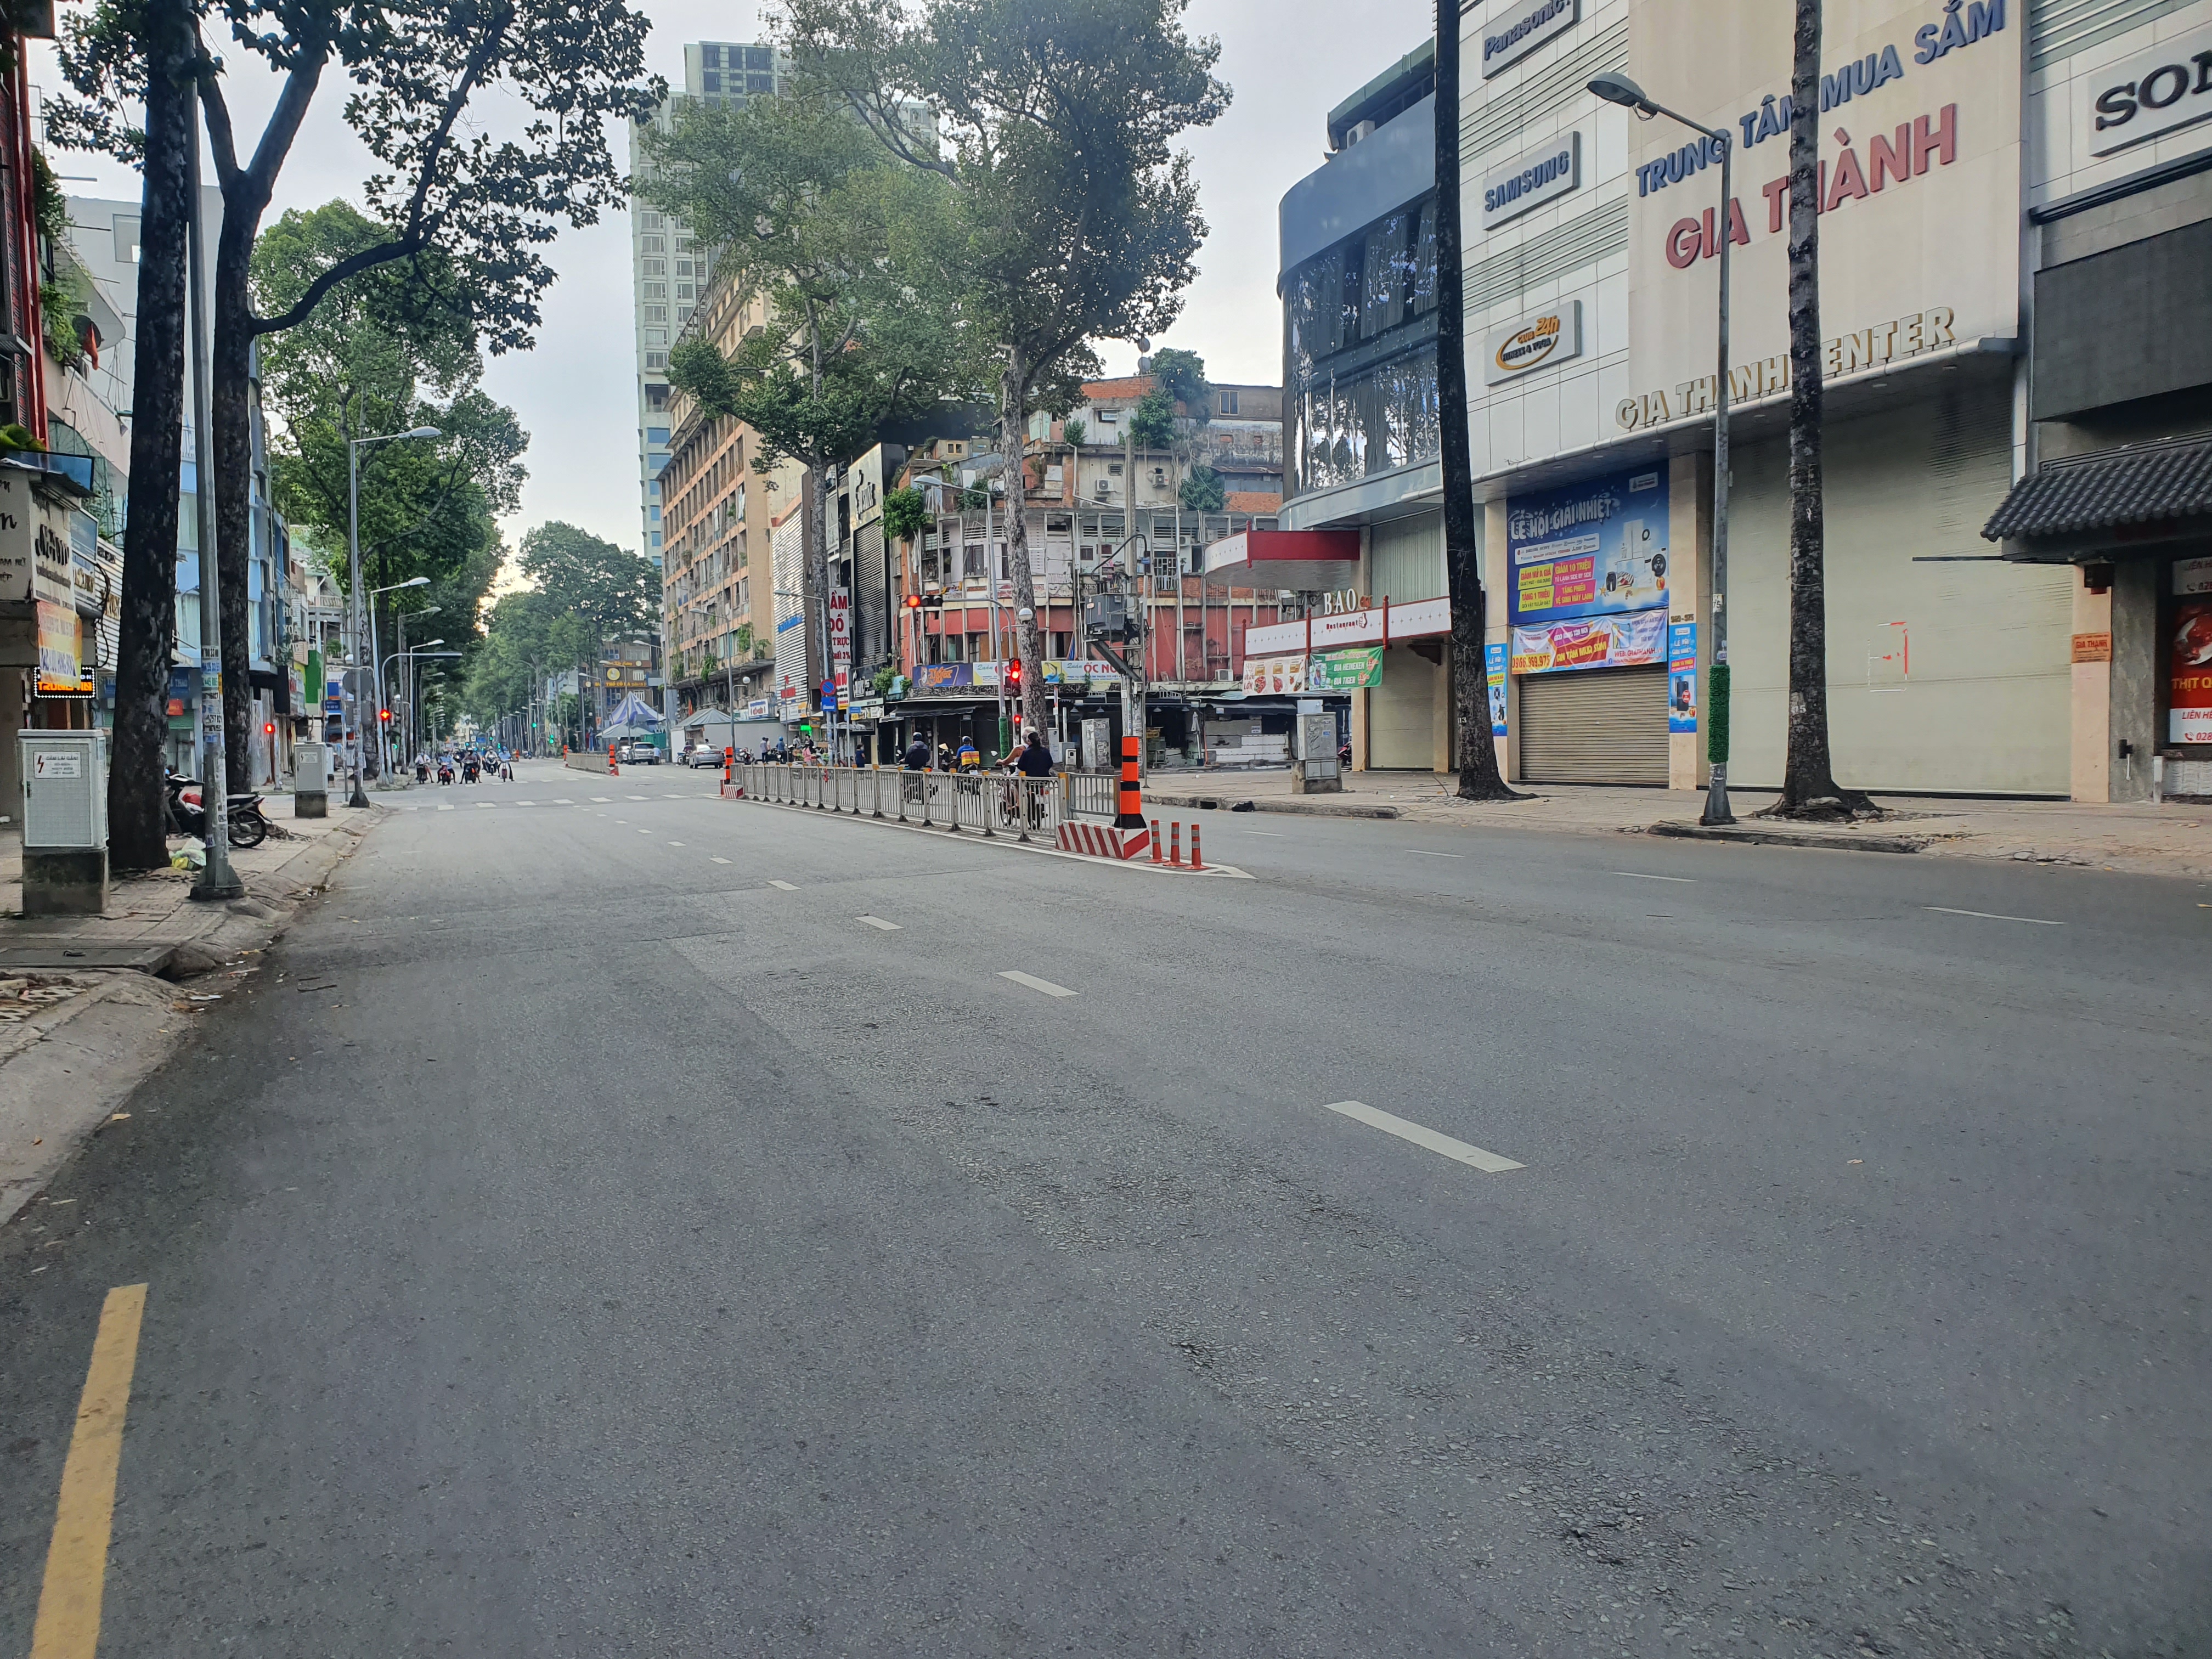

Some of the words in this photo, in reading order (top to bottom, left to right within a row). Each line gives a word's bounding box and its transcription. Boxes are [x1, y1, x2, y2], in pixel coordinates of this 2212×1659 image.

[1635, 129, 1730, 197] TRUNG
[1820, 44, 1904, 112] MUA
[1914, 0, 2005, 65] SẮM
[1485, 150, 1569, 212] SAMSUNG
[1666, 197, 1750, 269] GIA
[1763, 103, 1957, 234] TÀNH
[1616, 390, 1669, 429] GIA
[1578, 492, 1611, 523] NHIỆT
[1555, 563, 1569, 574] GIẢM
[1570, 563, 1576, 572] 10
[1576, 559, 1592, 571] TRIỆU
[1323, 588, 1359, 616] BAO
[1326, 619, 1359, 630] Restaurant
[832, 636, 850, 648] TRỰC
[1512, 655, 1551, 668] 0966.969.975
[1556, 653, 1565, 662] AN
[1084, 662, 1099, 673] ỐC
[1334, 663, 1342, 672] BIA
[1342, 662, 1365, 671] HEINEKEN
[928, 667, 952, 686] Tiger
[1342, 676, 1356, 685] TIGER
[2171, 677, 2199, 692] THỊT
[2182, 710, 2200, 720] LIÊN
